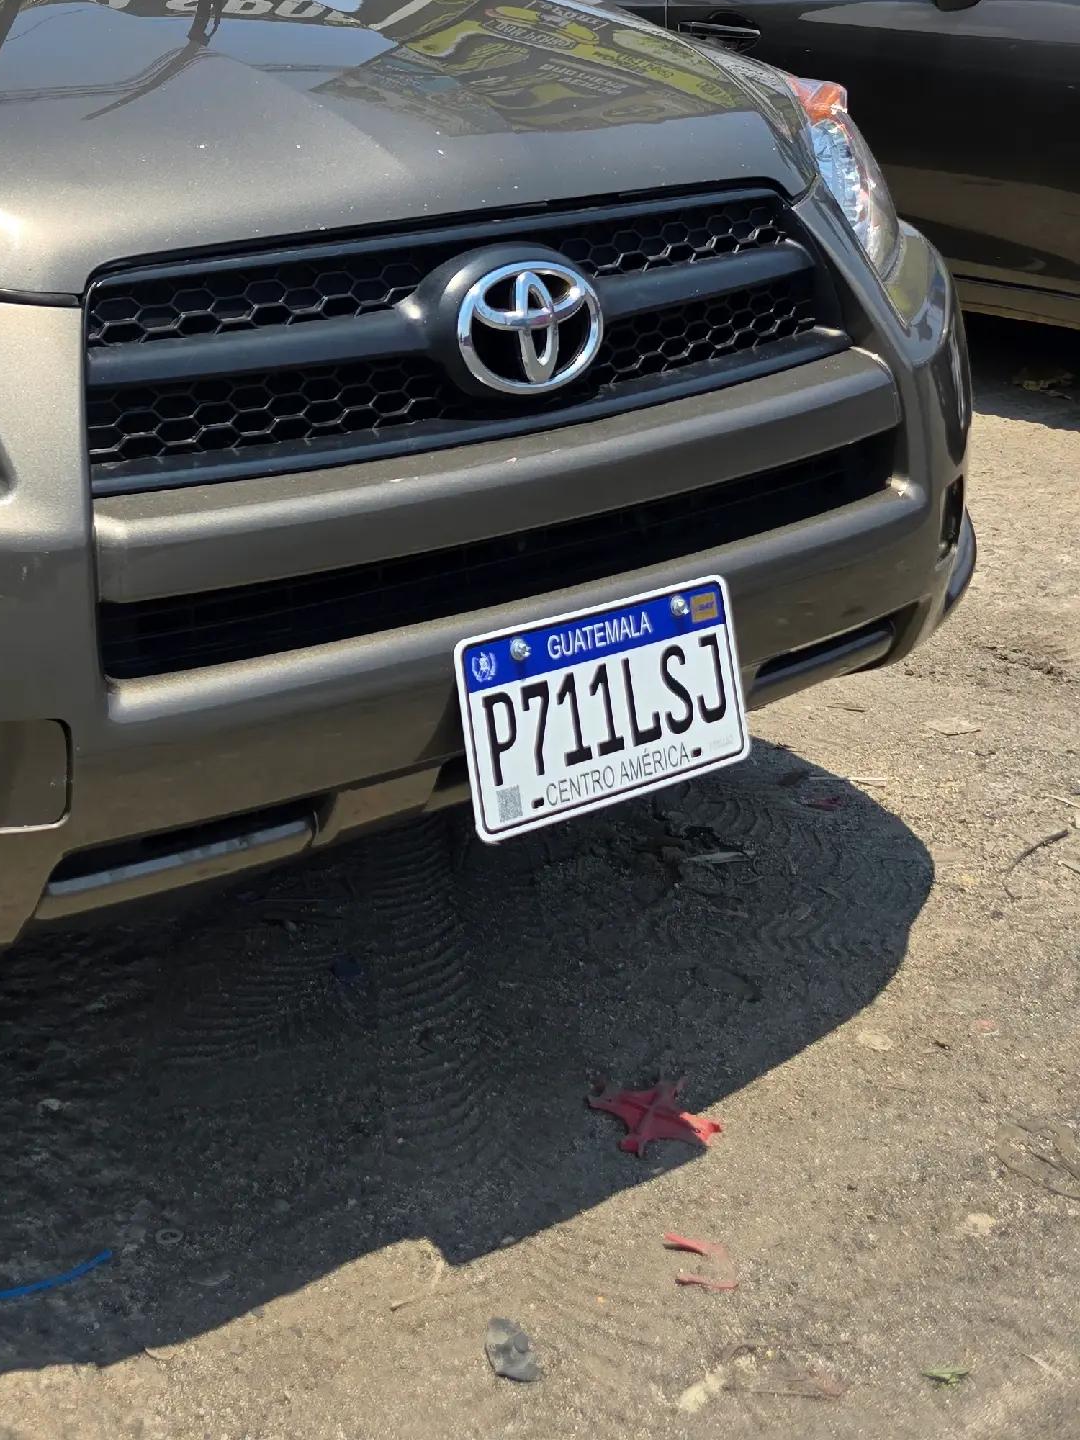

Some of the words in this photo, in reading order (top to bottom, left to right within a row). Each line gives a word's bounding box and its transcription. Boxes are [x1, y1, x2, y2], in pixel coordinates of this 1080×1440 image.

[547, 611, 653, 659] GUATEMALA
[481, 633, 727, 787] P711LSJ
[545, 765, 615, 807] CENTRO
[619, 741, 691, 782] AMÉRICA
